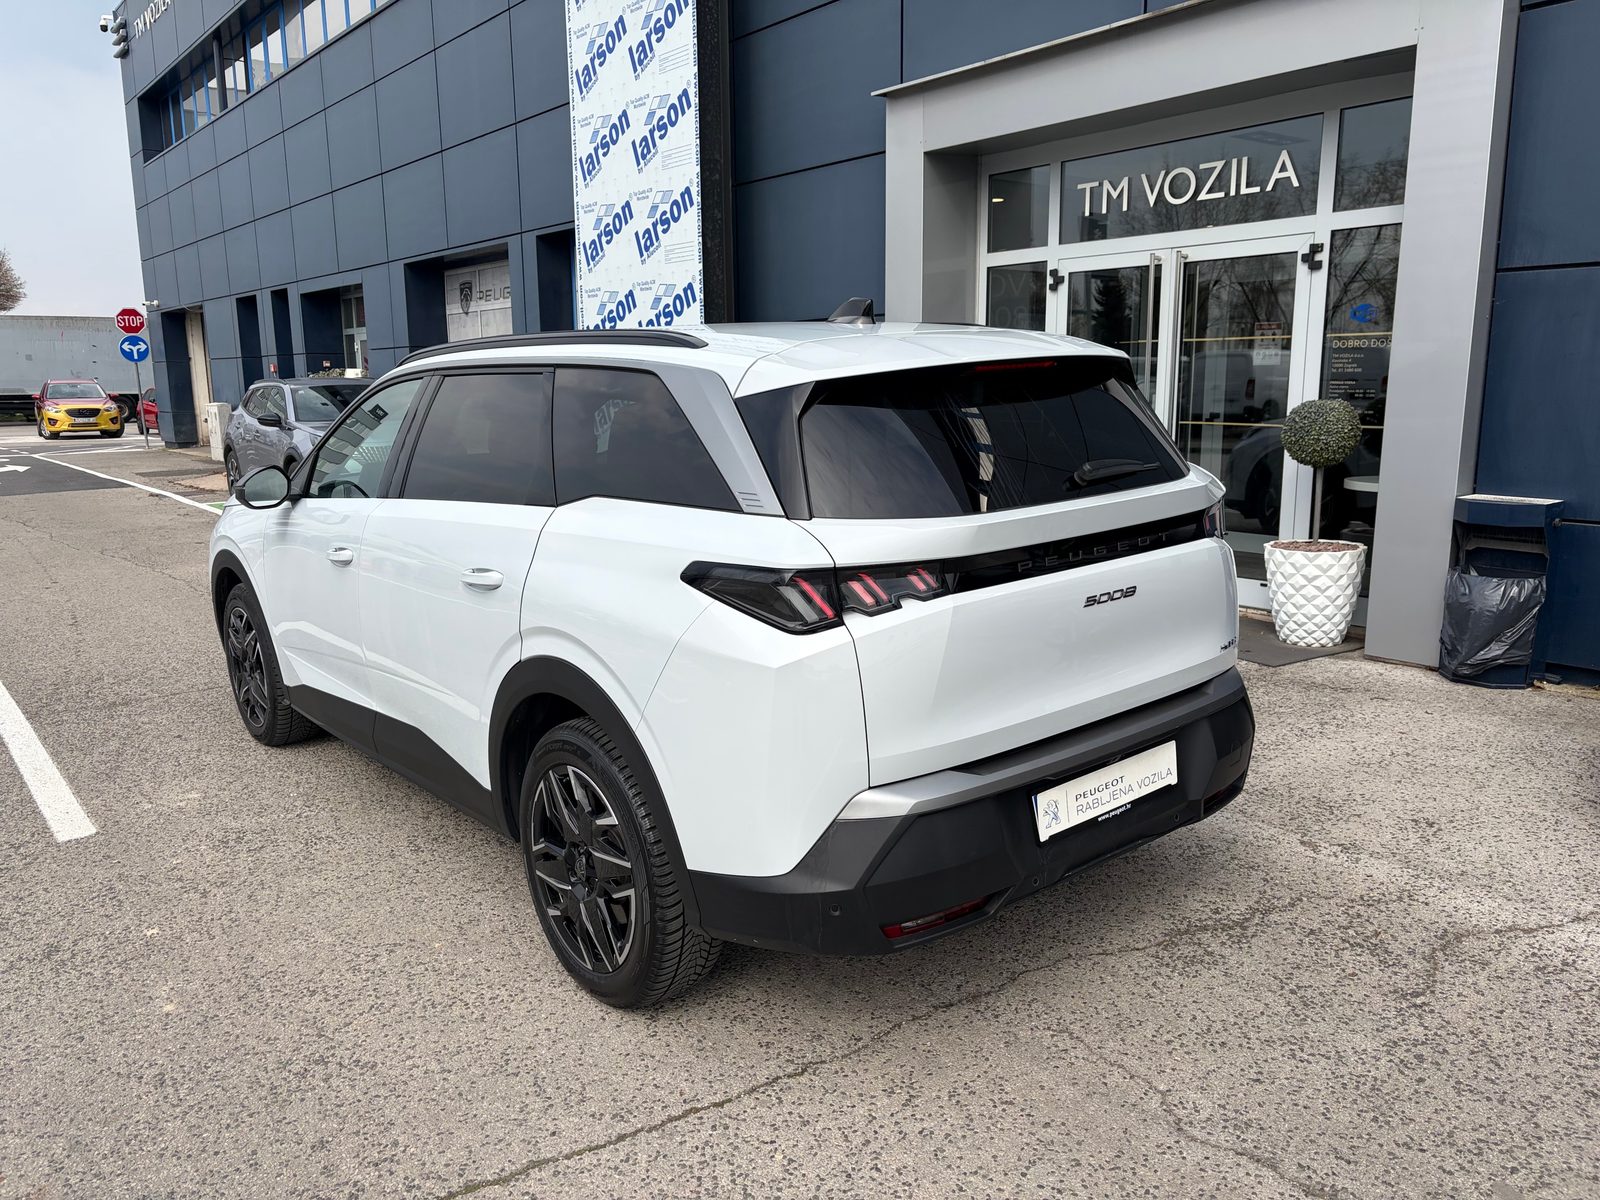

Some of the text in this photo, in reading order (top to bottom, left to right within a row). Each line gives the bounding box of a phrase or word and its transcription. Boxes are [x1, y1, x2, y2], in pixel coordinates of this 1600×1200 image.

[134, 0, 171, 39] TM VOZIL
[628, 0, 690, 75] larson
[567, 27, 575, 112] www.alucoil.com
[575, 14, 627, 96] larson
[571, 115, 579, 198] www.alucoil.com
[579, 109, 631, 182] larson
[631, 88, 692, 167] larson
[1077, 149, 1300, 217] TM VOZILA
[575, 201, 583, 281] www.alucoil.com
[582, 200, 634, 268] larson
[634, 186, 694, 258] larson
[117, 316, 143, 327] STOP
[1332, 339, 1369, 348] DOBRO
[1017, 532, 1169, 573] PEUGEOT
[1083, 585, 1137, 608] 5008
[1075, 775, 1125, 802] PEUGEOT
[1076, 767, 1173, 816] RABLJENA VOZILA
[1098, 803, 1132, 822] www.peugeot.hr
